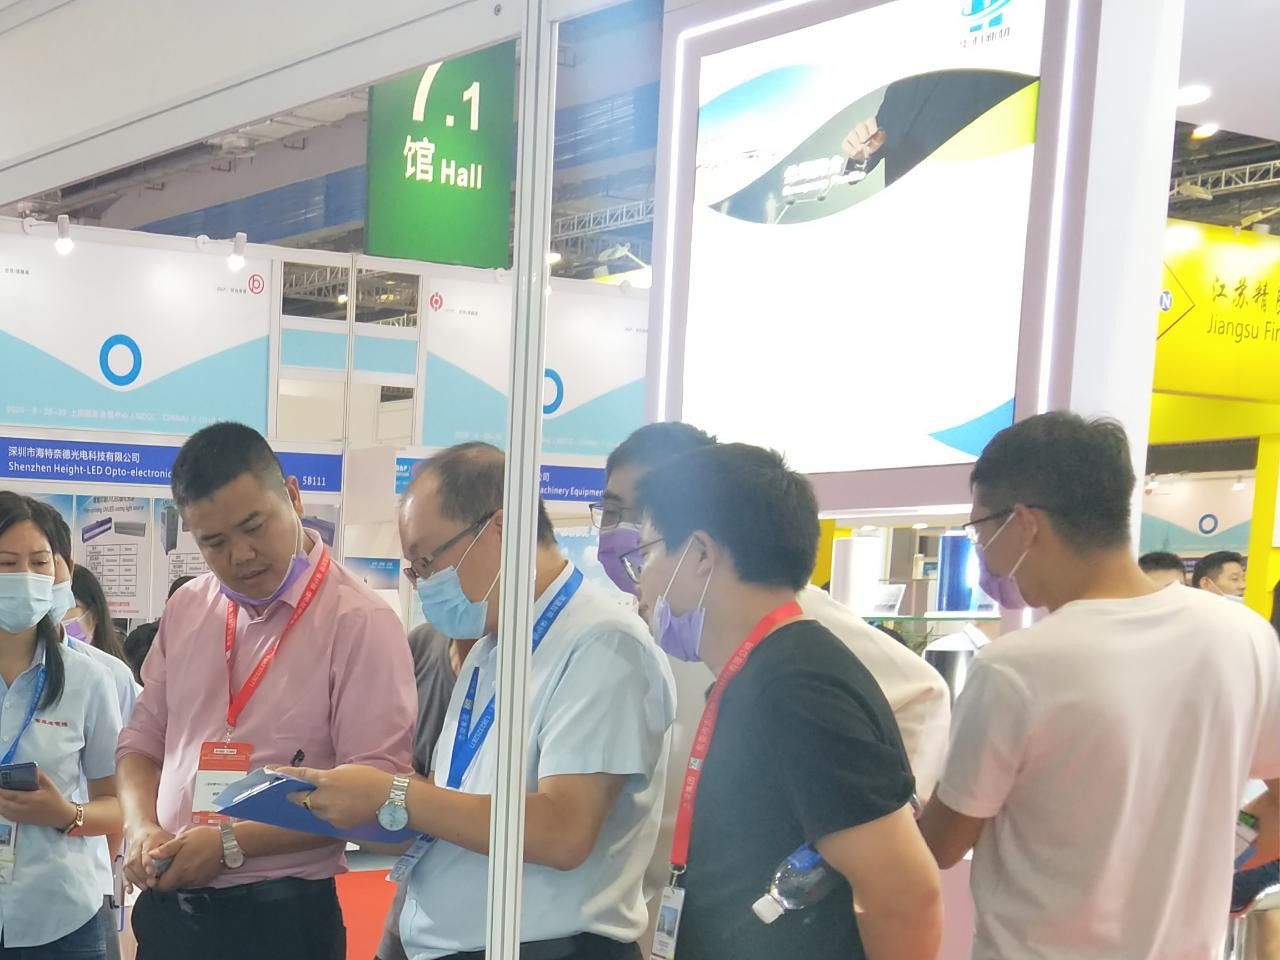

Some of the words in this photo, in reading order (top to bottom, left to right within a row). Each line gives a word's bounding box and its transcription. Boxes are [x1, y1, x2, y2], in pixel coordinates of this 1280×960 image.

[403, 134, 435, 182] 馆
[440, 158, 483, 190] Hall
[1211, 275, 1280, 315] 江苏精
[1206, 313, 1260, 344] Jiangsu
[8, 446, 141, 463] 深圳市海特奈德光电科技有限公司
[8, 461, 51, 473] Shenzhen
[54, 463, 103, 476] Height-LED
[302, 475, 326, 486] 5B111
